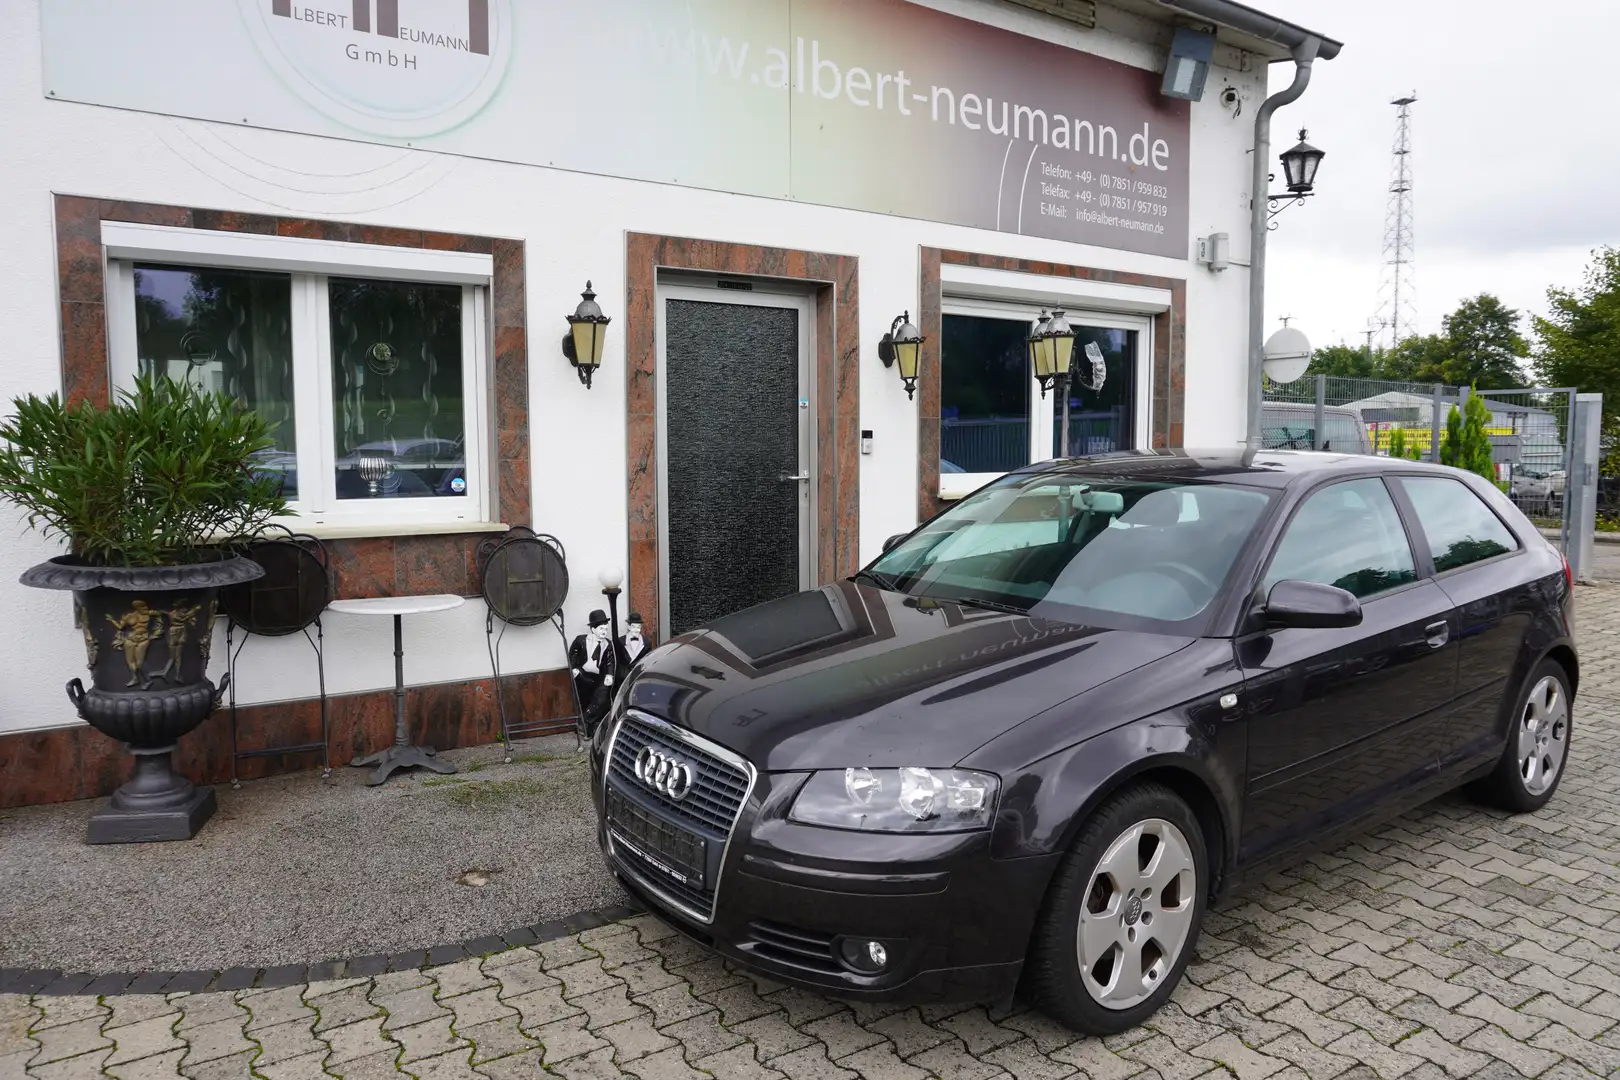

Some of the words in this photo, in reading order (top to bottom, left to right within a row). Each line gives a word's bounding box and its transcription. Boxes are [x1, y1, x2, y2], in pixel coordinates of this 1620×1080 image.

[1041, 162, 1072, 180] Telefon:
[1100, 173, 1110, 189] (0)
[1112, 176, 1131, 191] 7851
[1040, 182, 1070, 200] Telefax:
[1099, 193, 1110, 209] (0)
[1112, 195, 1131, 210] 7851
[1040, 202, 1067, 219] E-Mail:
[1076, 208, 1164, 235] info@albert-neumann.de
